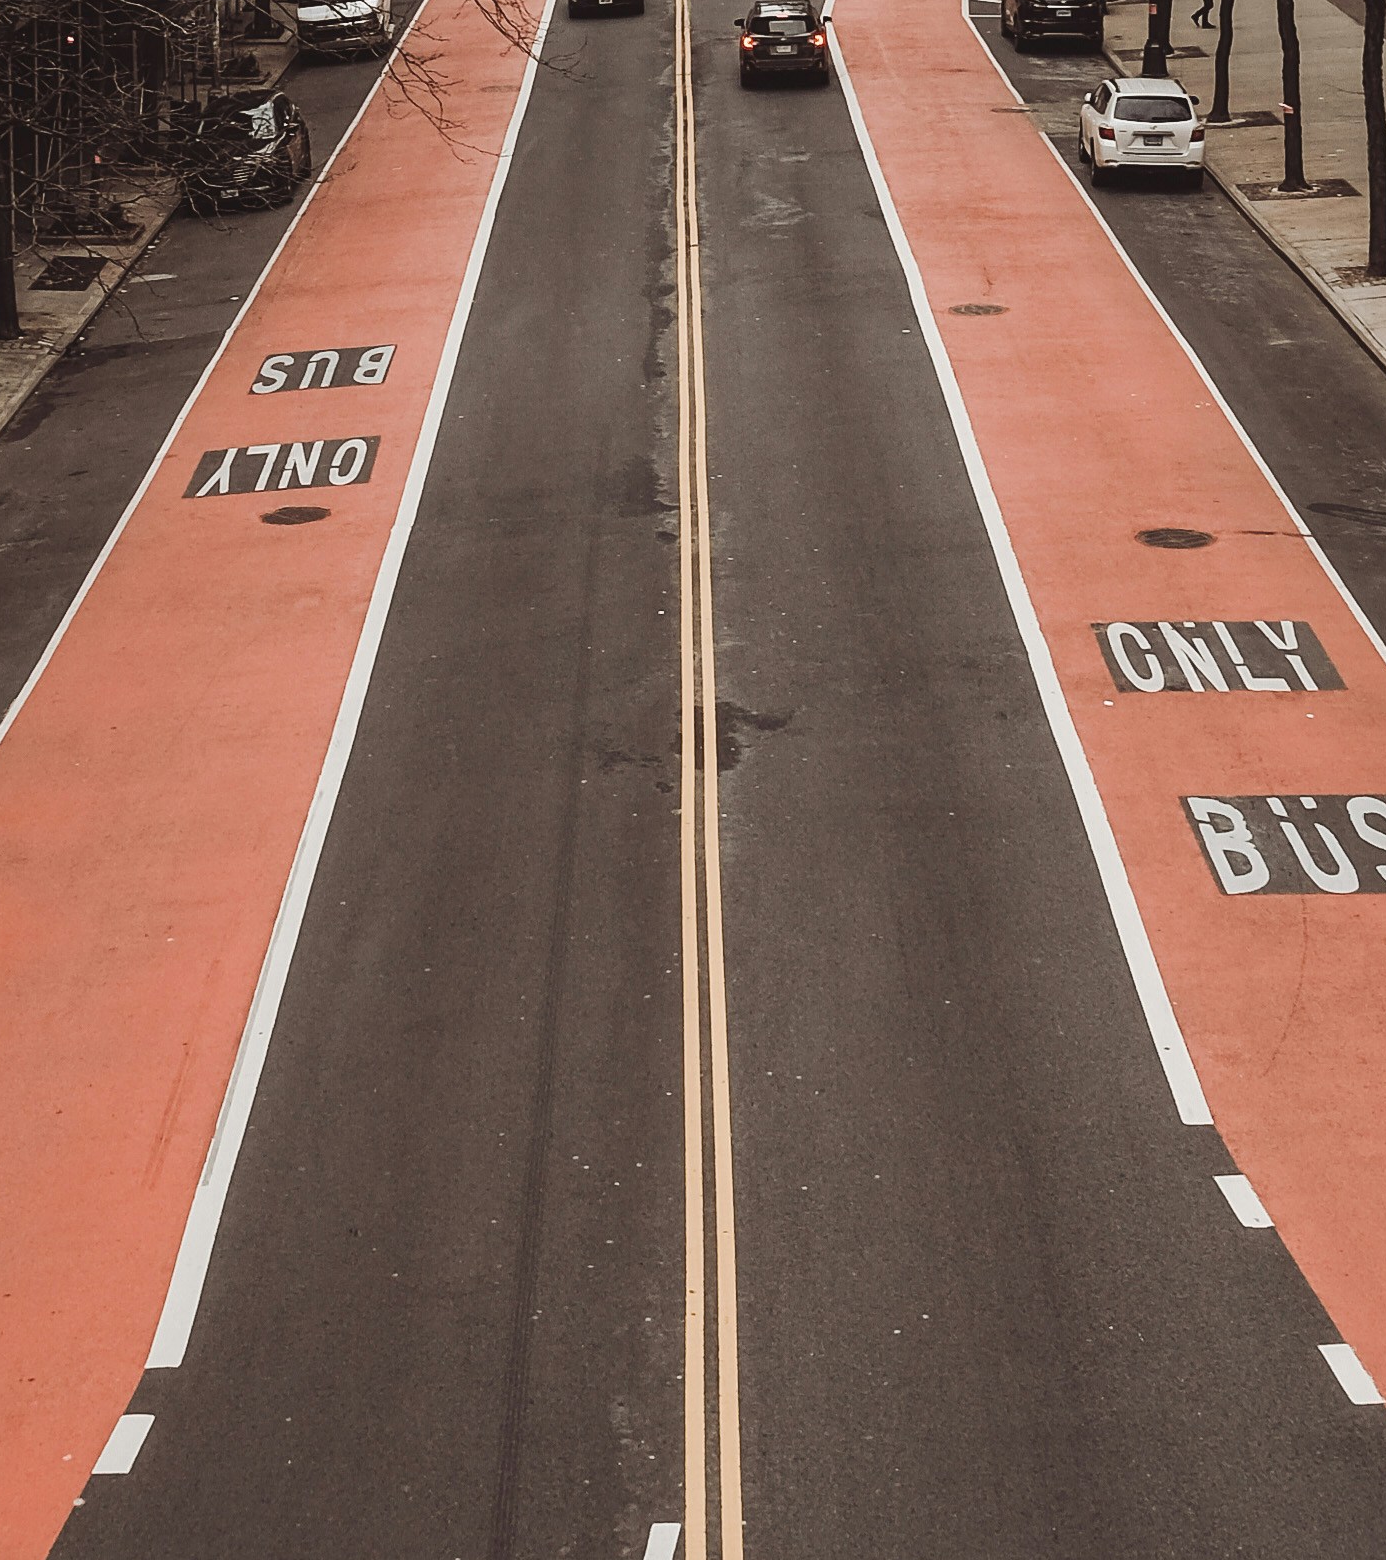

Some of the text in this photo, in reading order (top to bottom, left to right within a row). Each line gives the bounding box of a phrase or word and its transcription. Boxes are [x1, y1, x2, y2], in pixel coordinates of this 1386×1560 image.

[251, 344, 397, 395] BUS
[195, 438, 368, 498] ONLY
[1106, 620, 1319, 693] ONLY
